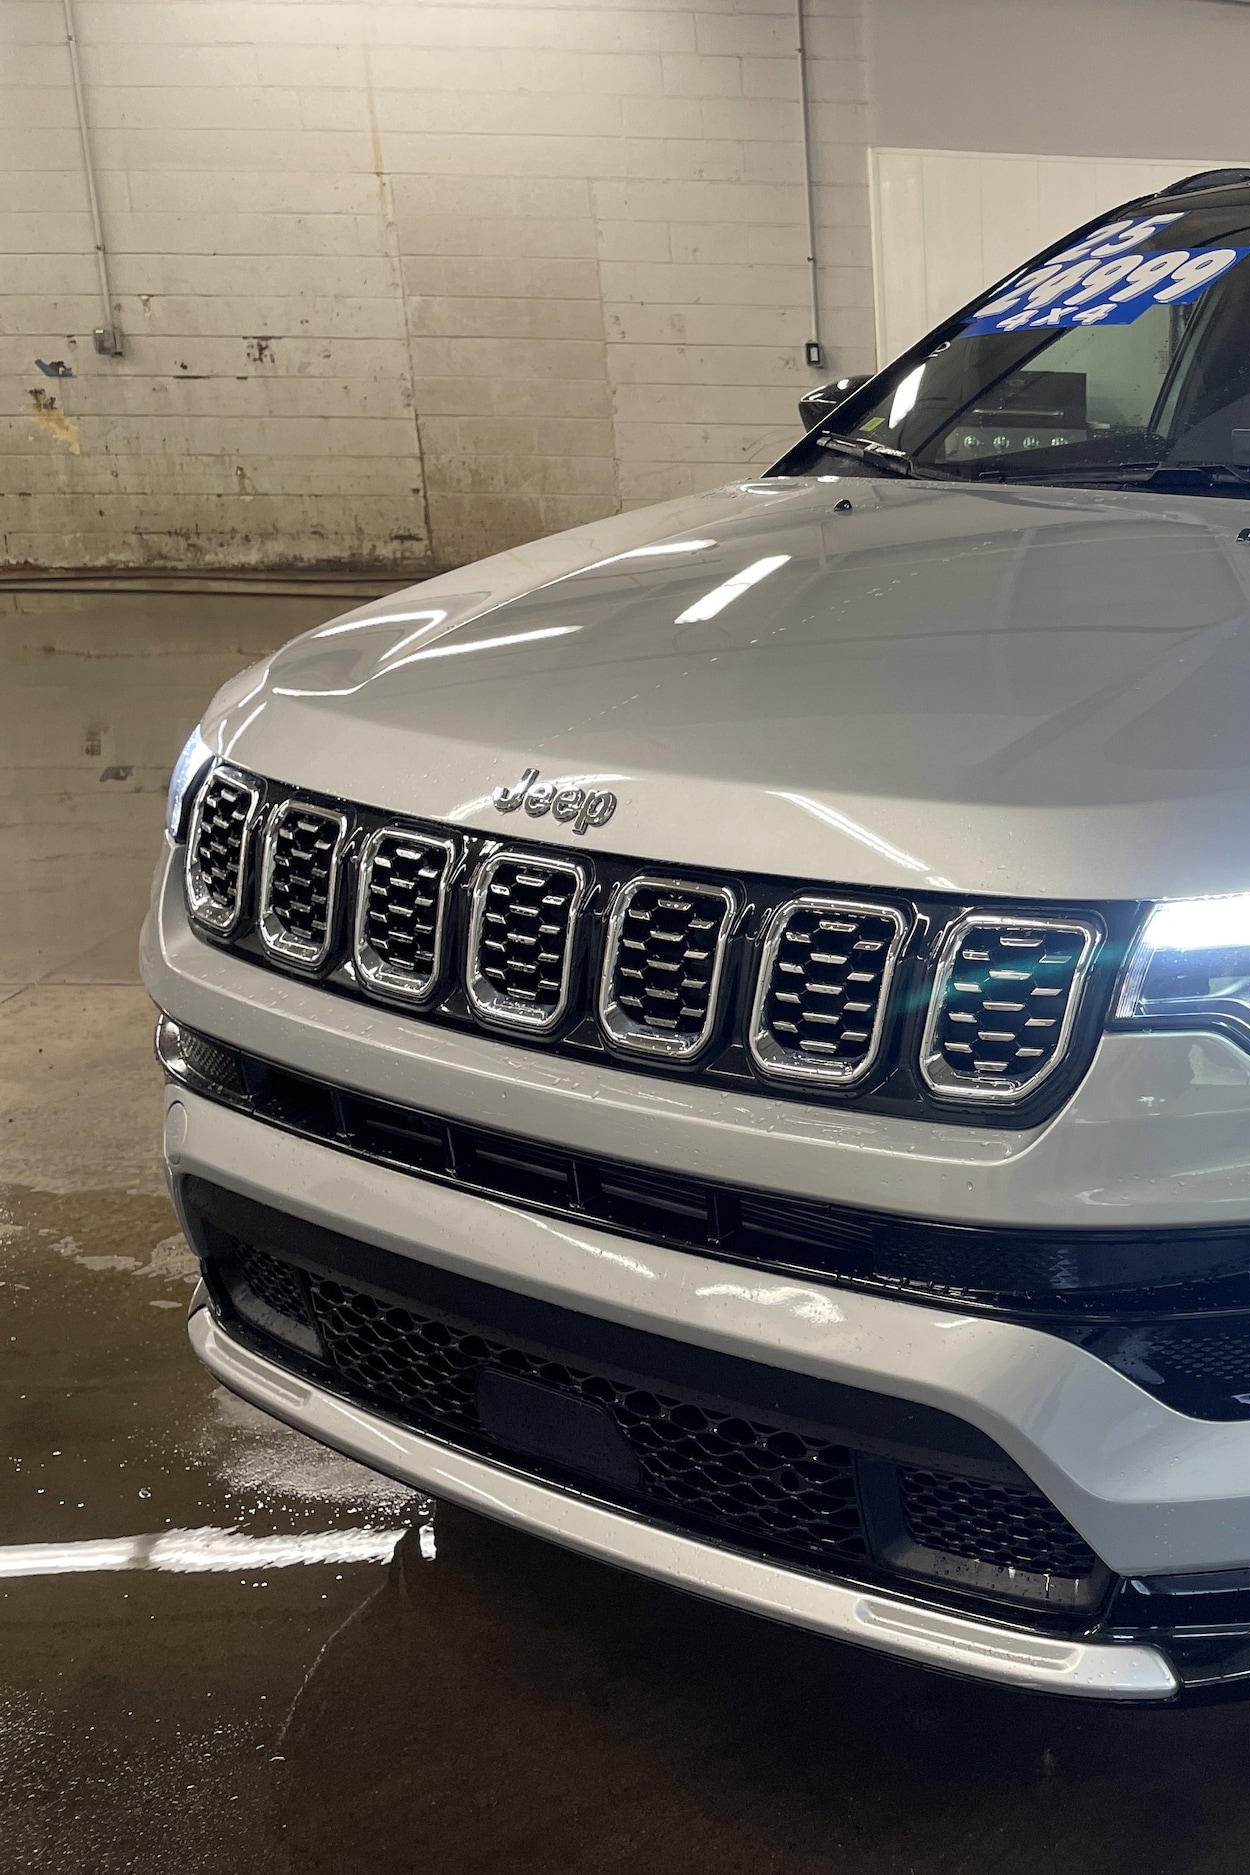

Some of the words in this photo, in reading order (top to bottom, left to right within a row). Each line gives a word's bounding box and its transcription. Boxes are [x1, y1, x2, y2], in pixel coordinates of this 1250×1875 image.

[1044, 211, 1187, 266] 25
[972, 249, 1238, 319] 24999
[492, 768, 617, 835] Jeep
